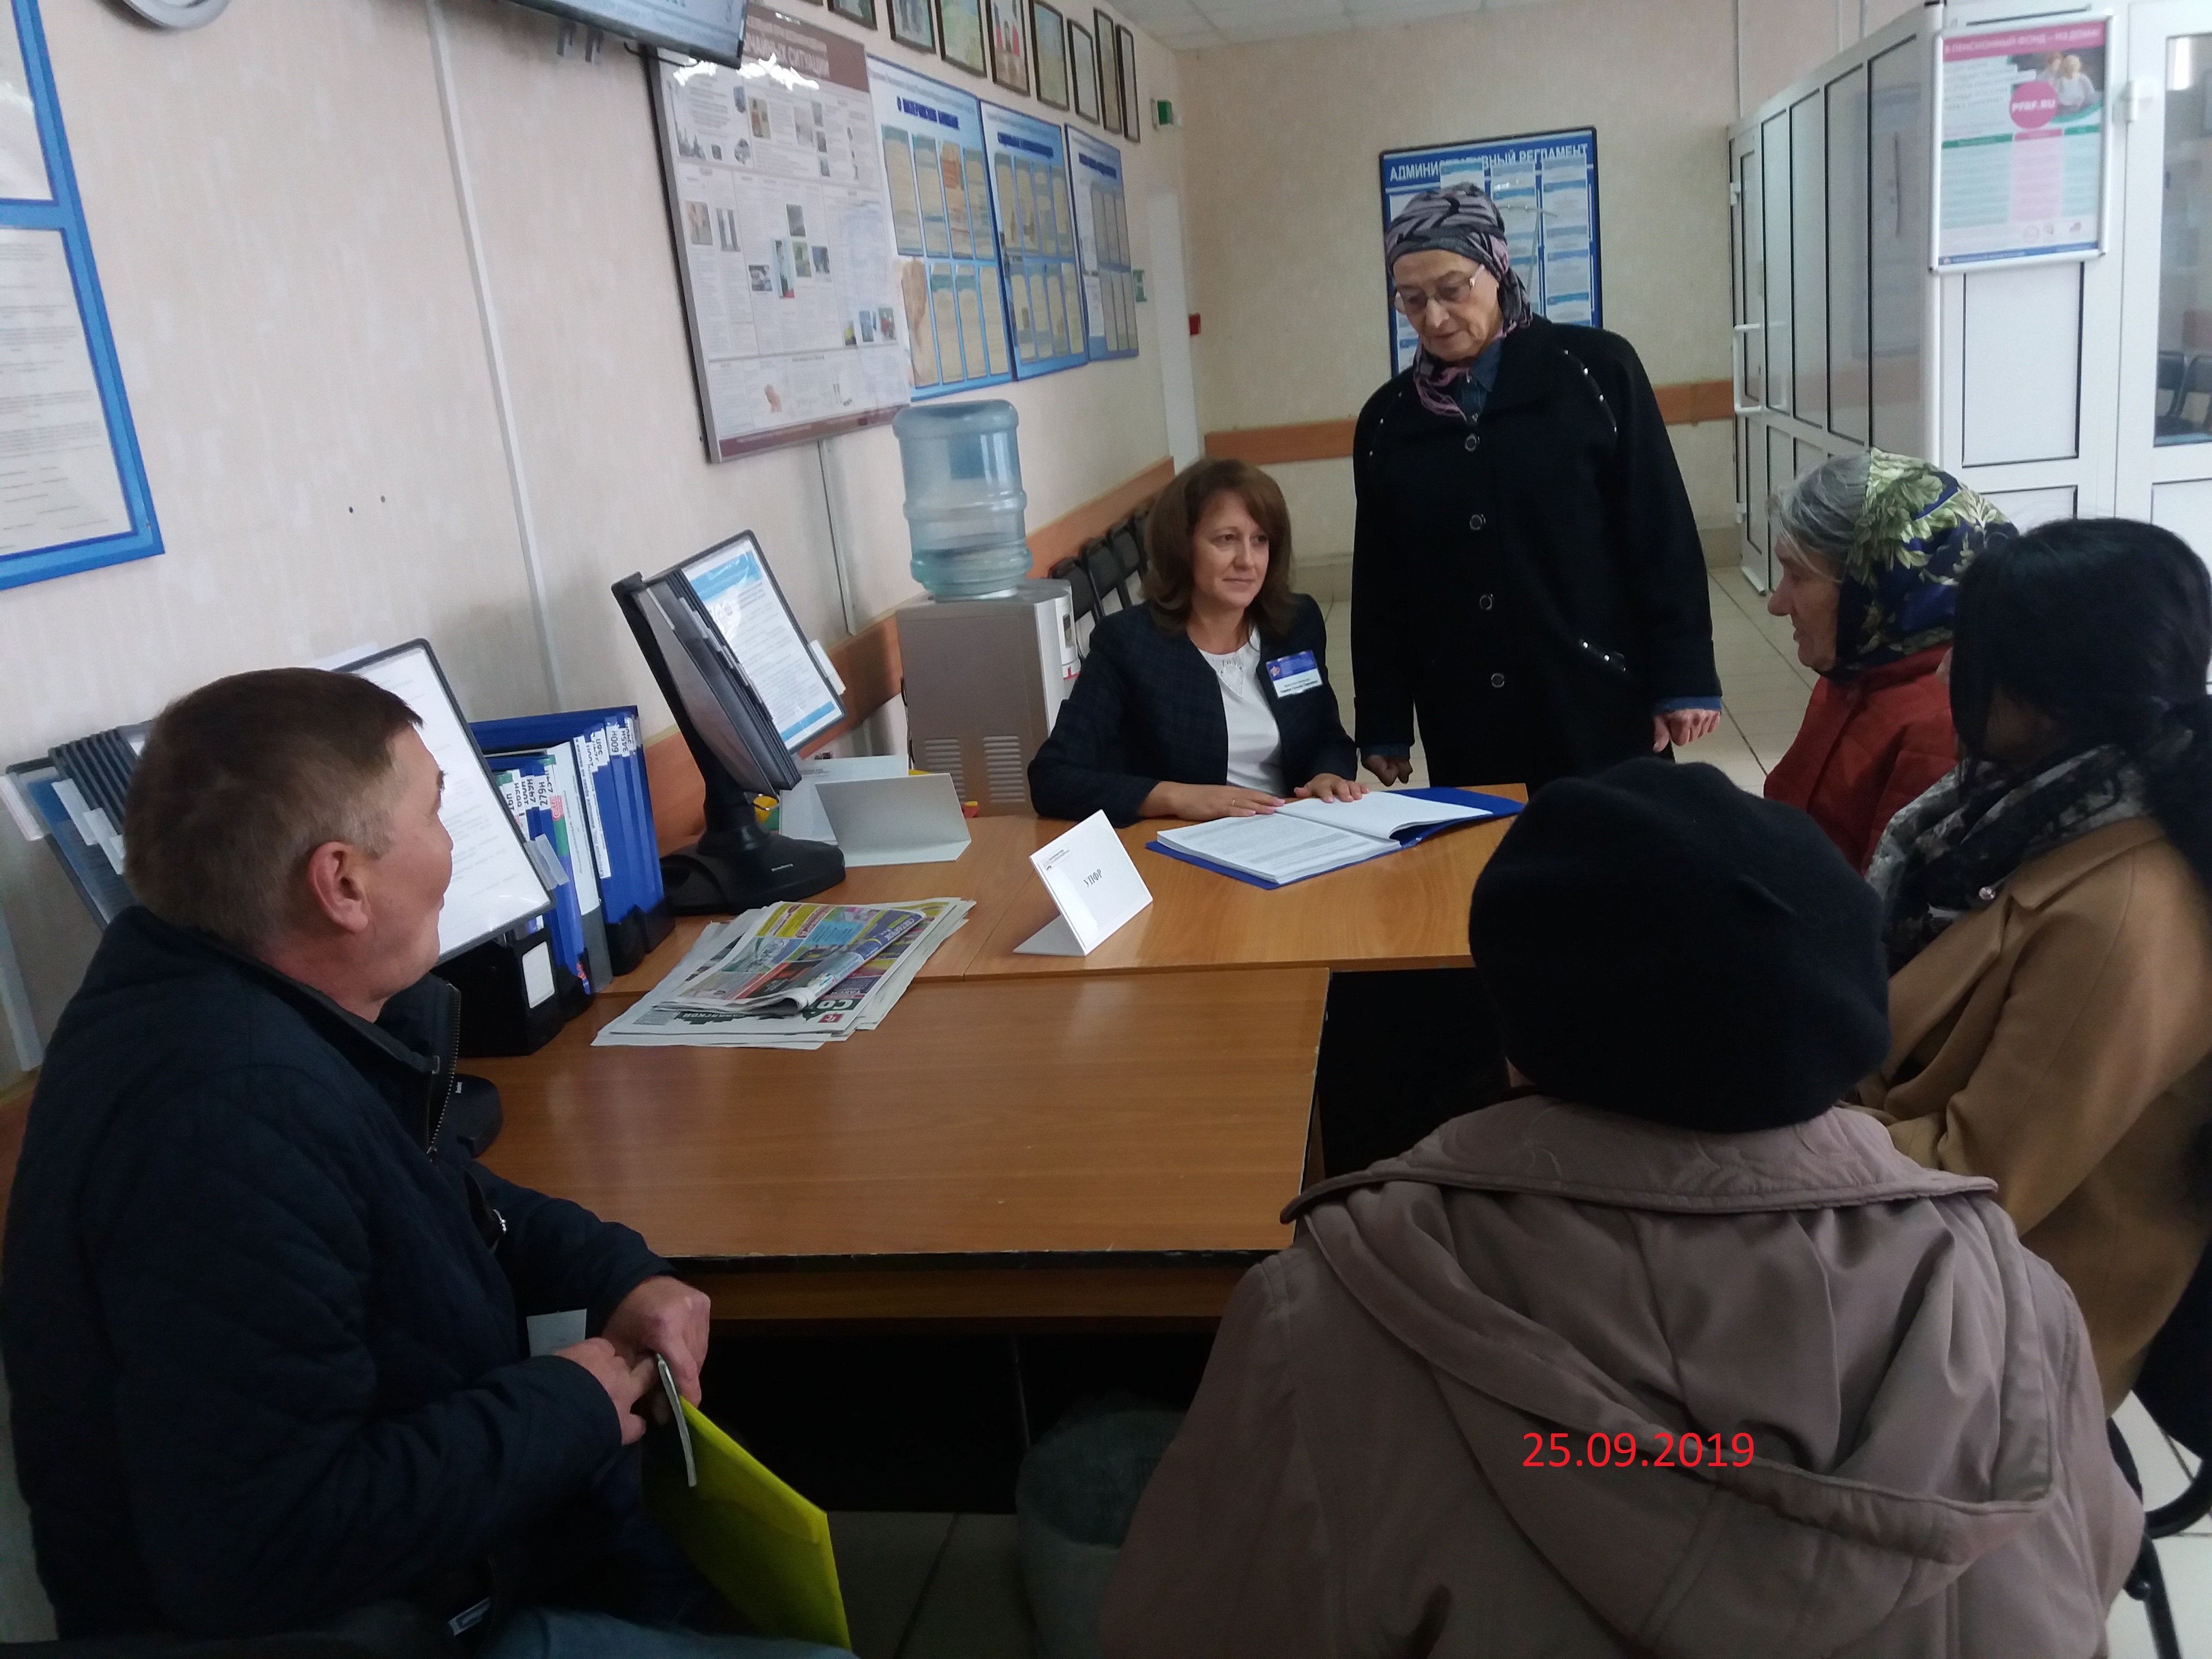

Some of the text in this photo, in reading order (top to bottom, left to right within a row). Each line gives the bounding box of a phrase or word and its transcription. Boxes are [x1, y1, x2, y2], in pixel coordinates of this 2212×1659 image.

[610, 730, 619, 753] 600н
[537, 781, 548, 806] 279н
[1083, 869, 1102, 888] УПФР
